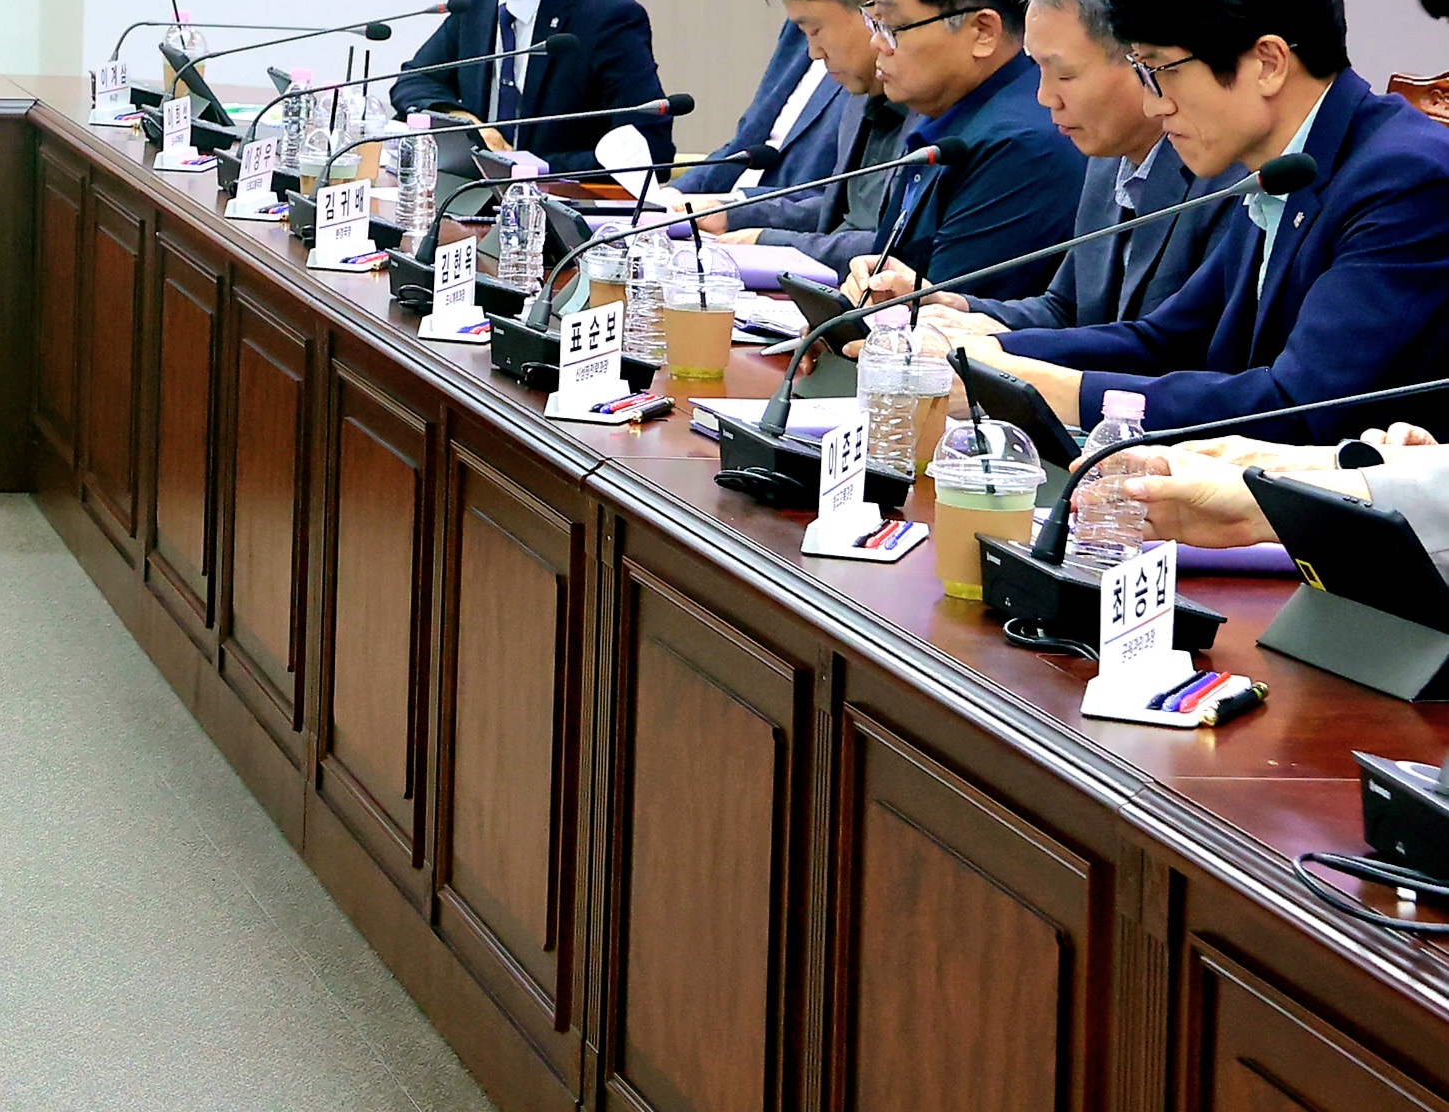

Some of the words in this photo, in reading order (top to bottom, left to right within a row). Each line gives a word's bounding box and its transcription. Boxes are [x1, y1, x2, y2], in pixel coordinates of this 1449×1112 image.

[569, 310, 616, 353] 표순보
[828, 425, 863, 480] 이준표
[1112, 555, 1169, 626] 최승갑
